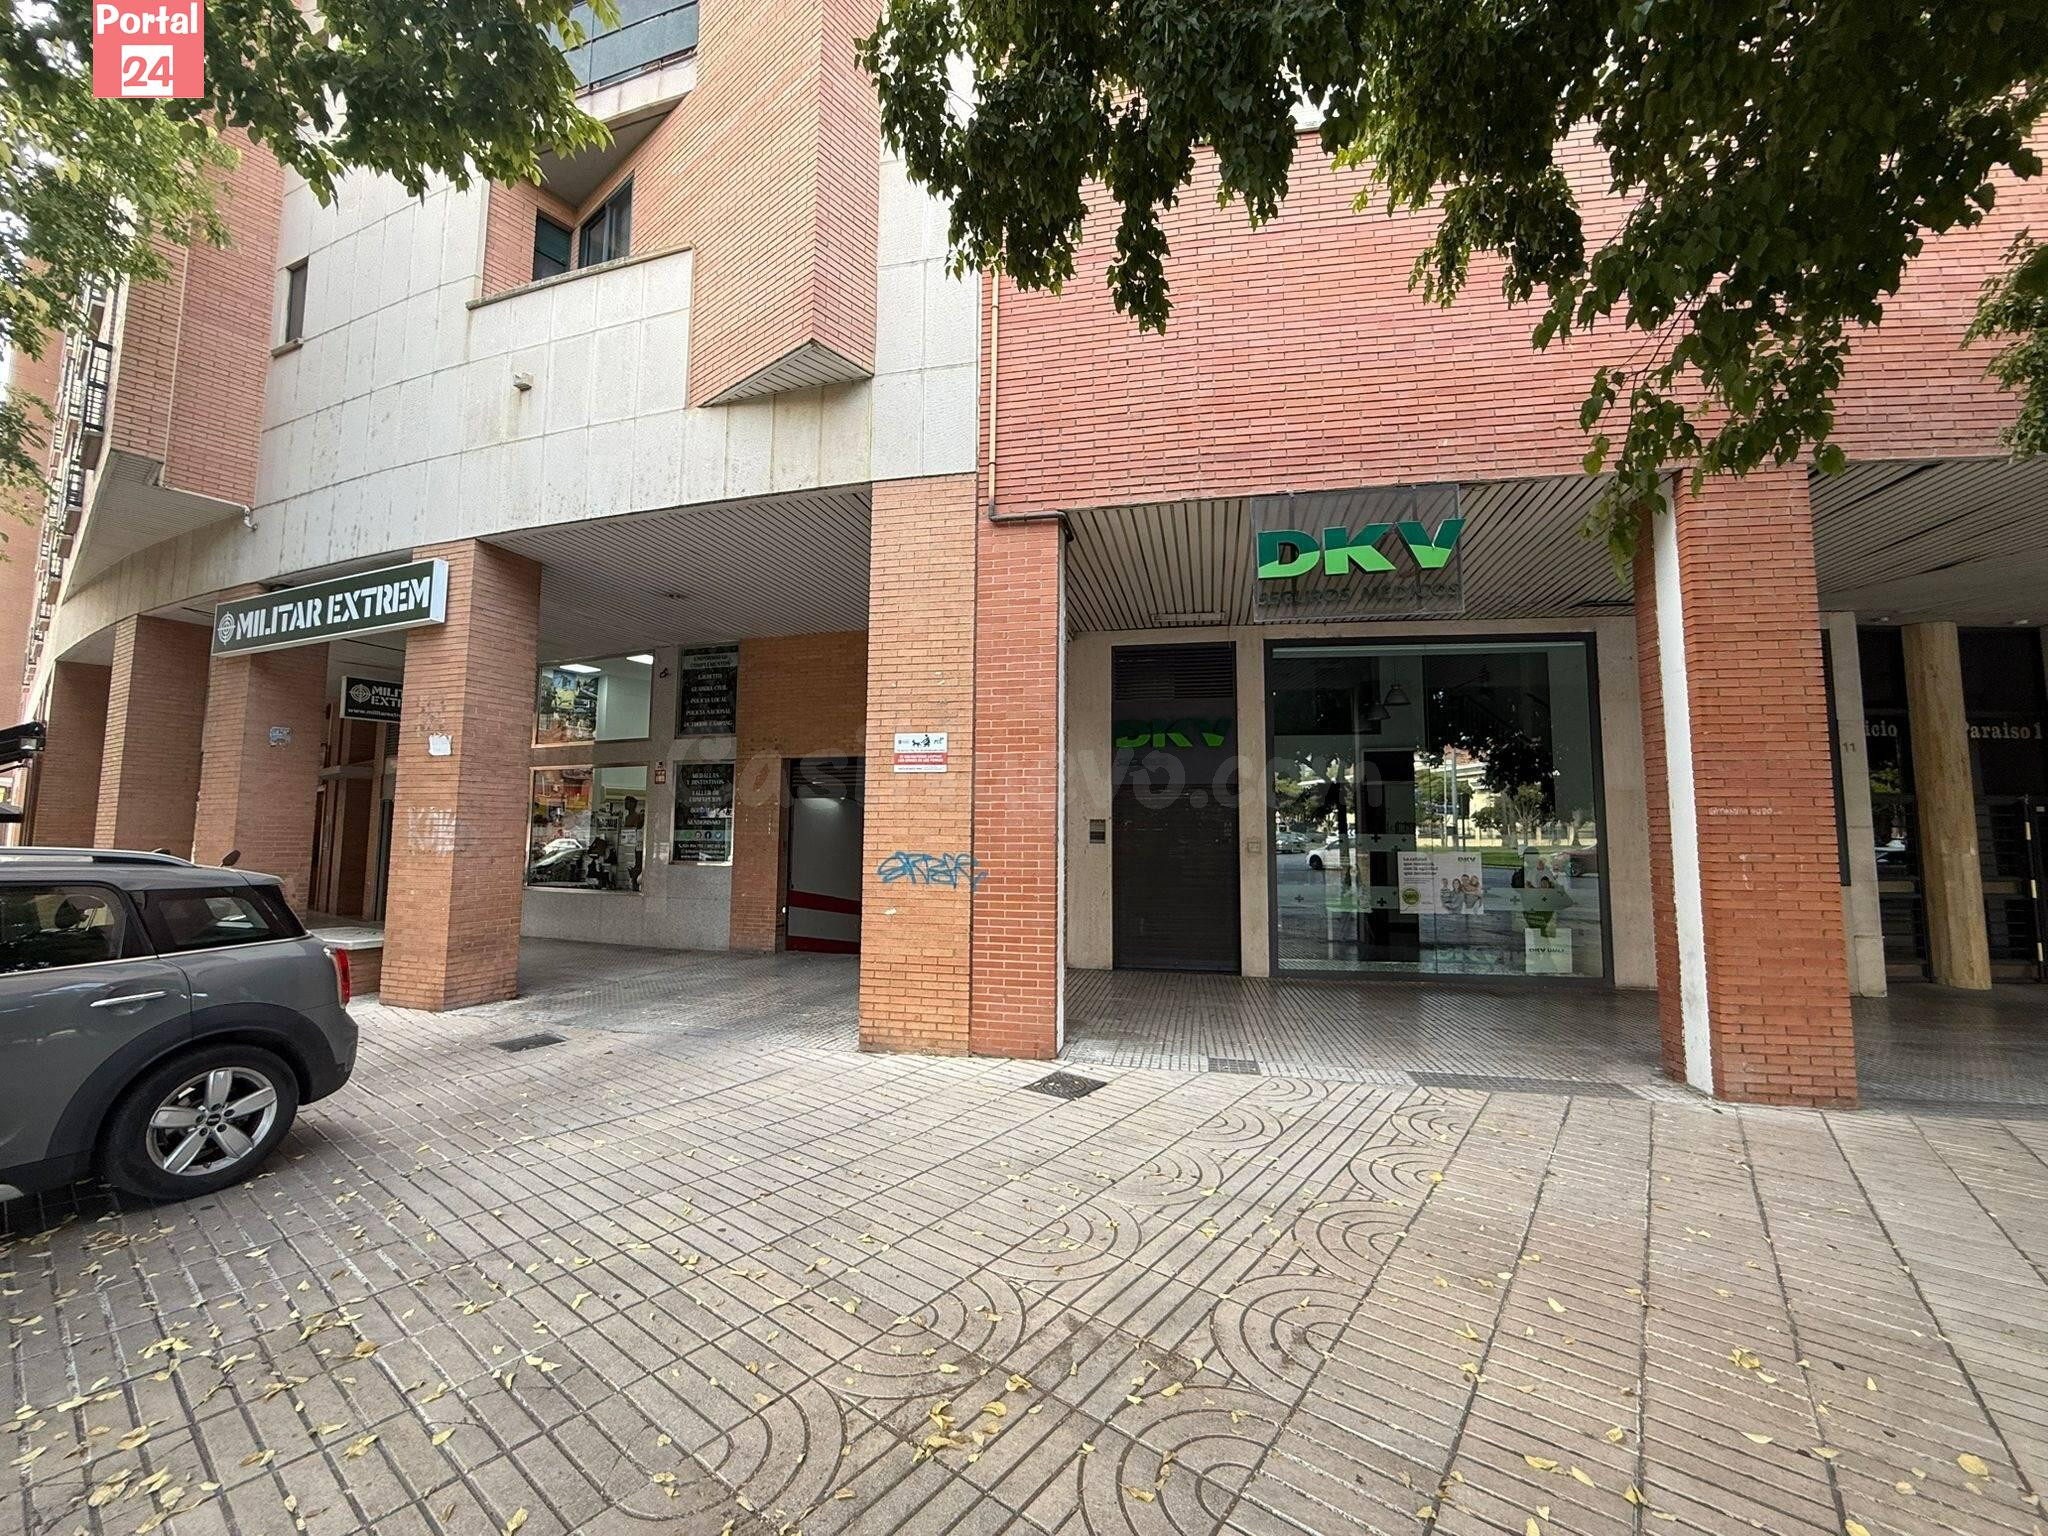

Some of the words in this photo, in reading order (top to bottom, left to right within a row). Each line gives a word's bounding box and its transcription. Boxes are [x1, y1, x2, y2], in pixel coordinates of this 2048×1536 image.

[1257, 518, 1466, 579] DKV
[236, 598, 322, 640] MILITAR
[327, 576, 431, 624] EXTREM
[1258, 588, 1351, 606] SEGUROS
[1115, 718, 1233, 749] DKV
[1966, 722, 2030, 739] araiso
[1842, 742, 1857, 752] 11
